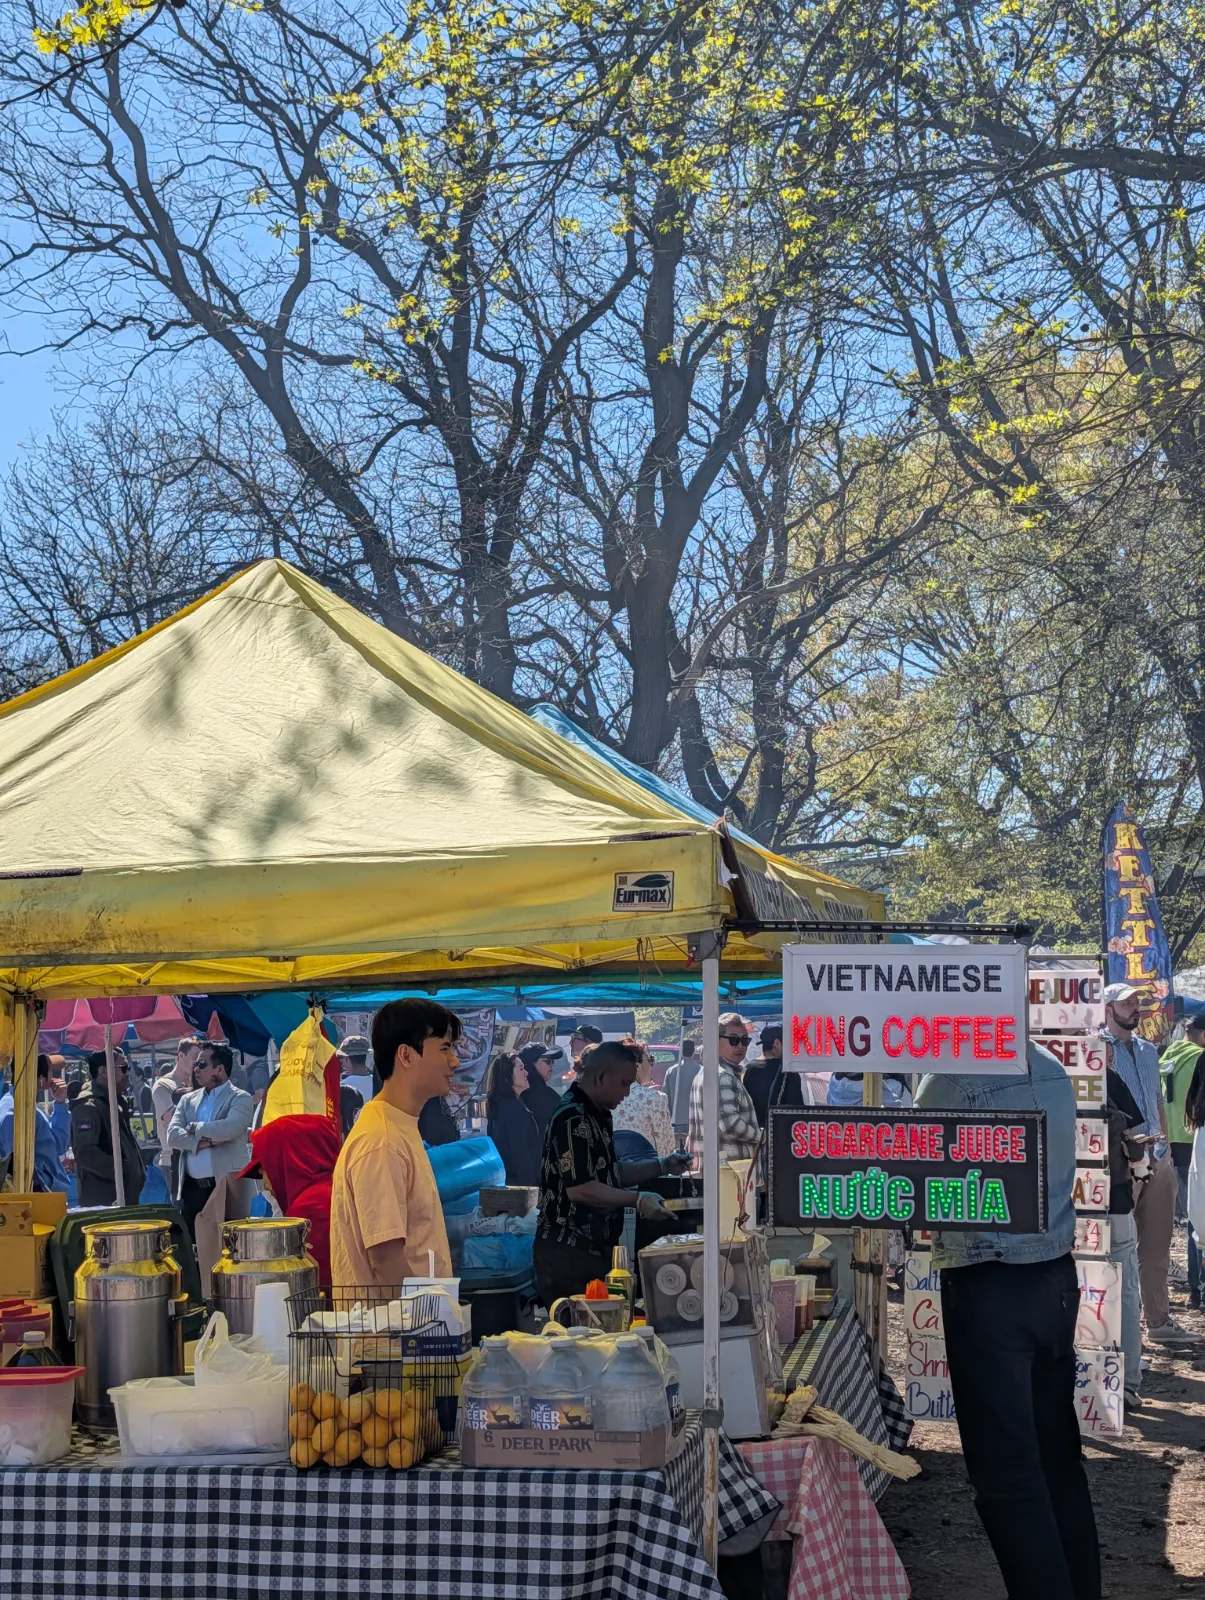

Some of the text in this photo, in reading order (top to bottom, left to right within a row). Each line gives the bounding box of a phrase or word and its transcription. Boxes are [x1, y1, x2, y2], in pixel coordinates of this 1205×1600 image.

[616, 887, 667, 904] Eurmax
[806, 964, 1002, 992] VIETNAMESE
[1049, 977, 1101, 1004] JUICE
[792, 1014, 1017, 1060] KING COFFEE
[791, 1122, 1027, 1163] SUGARCANE JUICE
[799, 1166, 1011, 1224] NƯỚC MÍA
[906, 1259, 941, 1291] Salt
[530, 1408, 561, 1423] DEER
[484, 1430, 494, 1443] 6
[501, 1437, 593, 1453] DEER PARK
